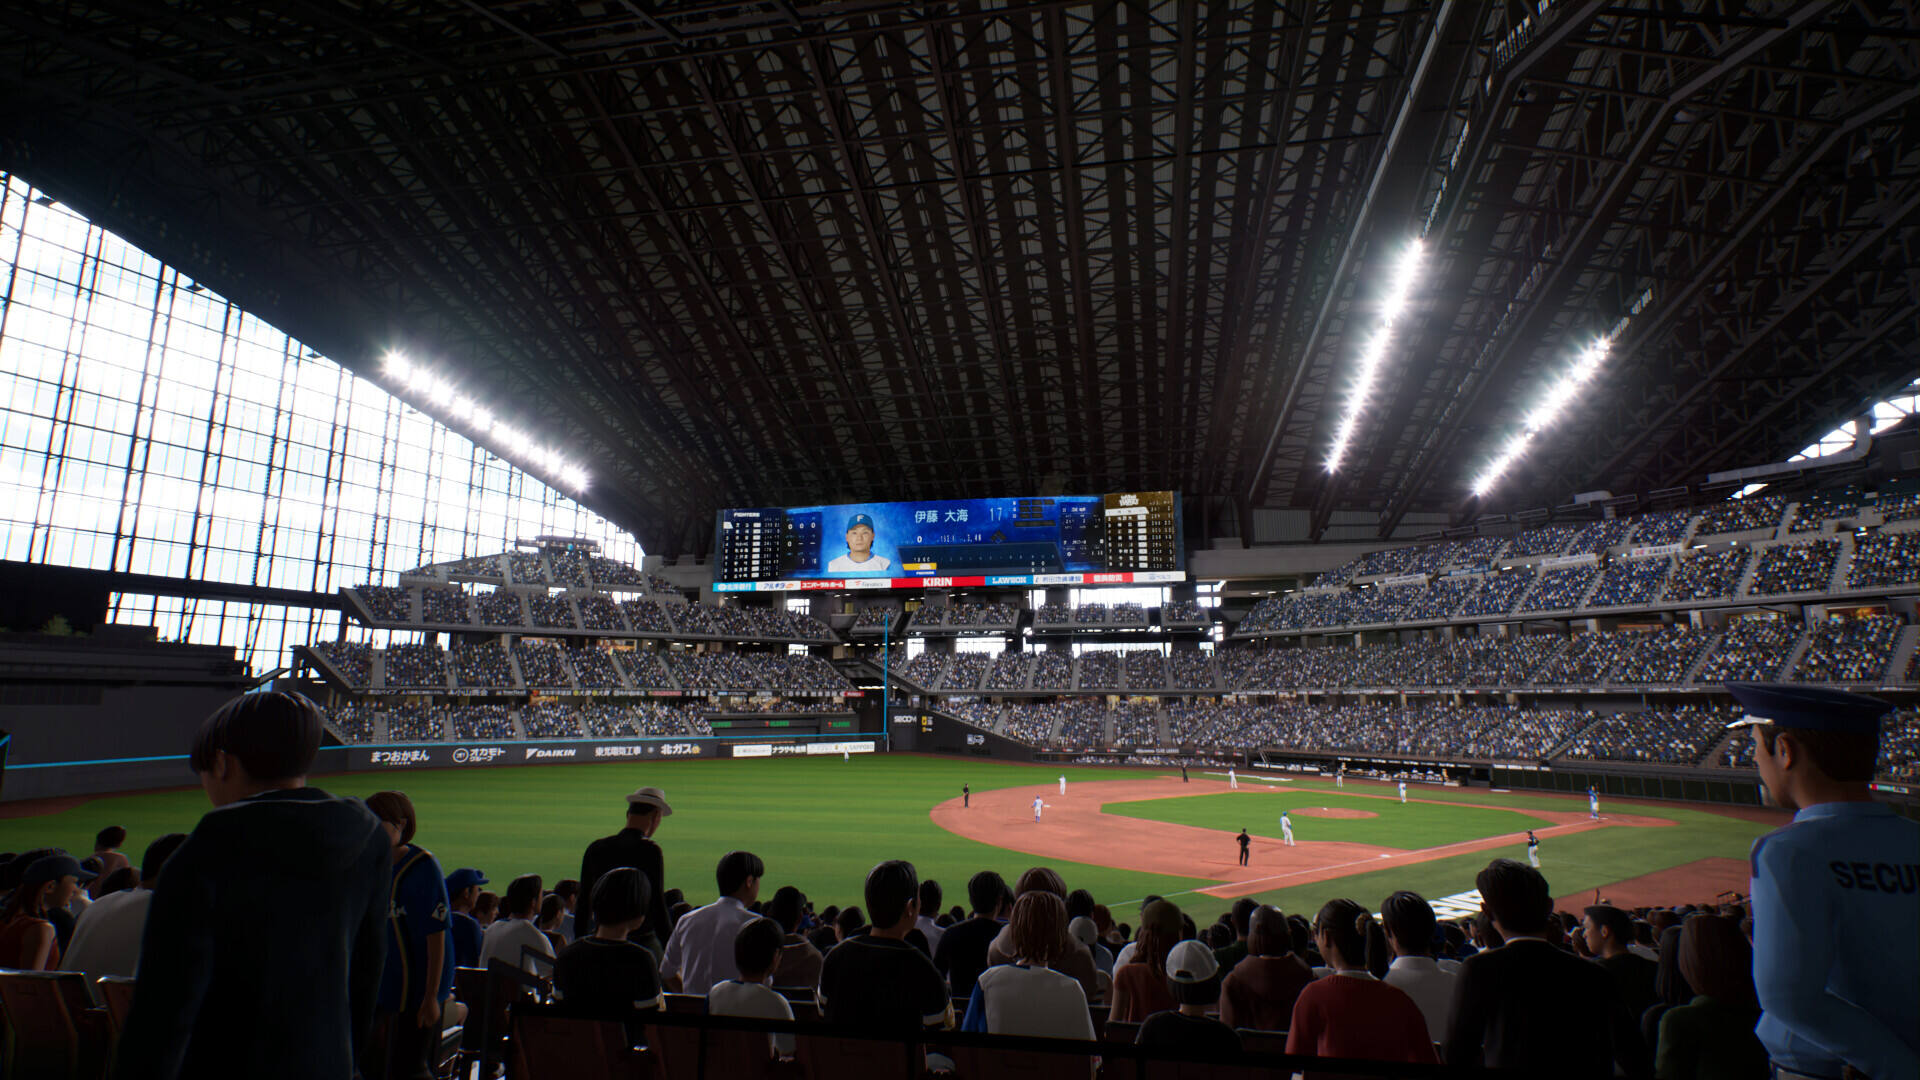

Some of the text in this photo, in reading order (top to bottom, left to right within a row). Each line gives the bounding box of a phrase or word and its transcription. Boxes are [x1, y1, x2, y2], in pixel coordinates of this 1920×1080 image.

[857, 514, 865, 522] F
[914, 508, 969, 524] 伊藤 大海
[990, 507, 1002, 521] 17
[917, 535, 923, 543] 0
[923, 576, 952, 587] KIRIN
[992, 576, 1027, 585] LAWSON
[468, 747, 506, 757] オカモト
[536, 749, 576, 757] DAIKIN
[660, 743, 693, 755] 北ガス
[1829, 860, 1920, 895] SECU
